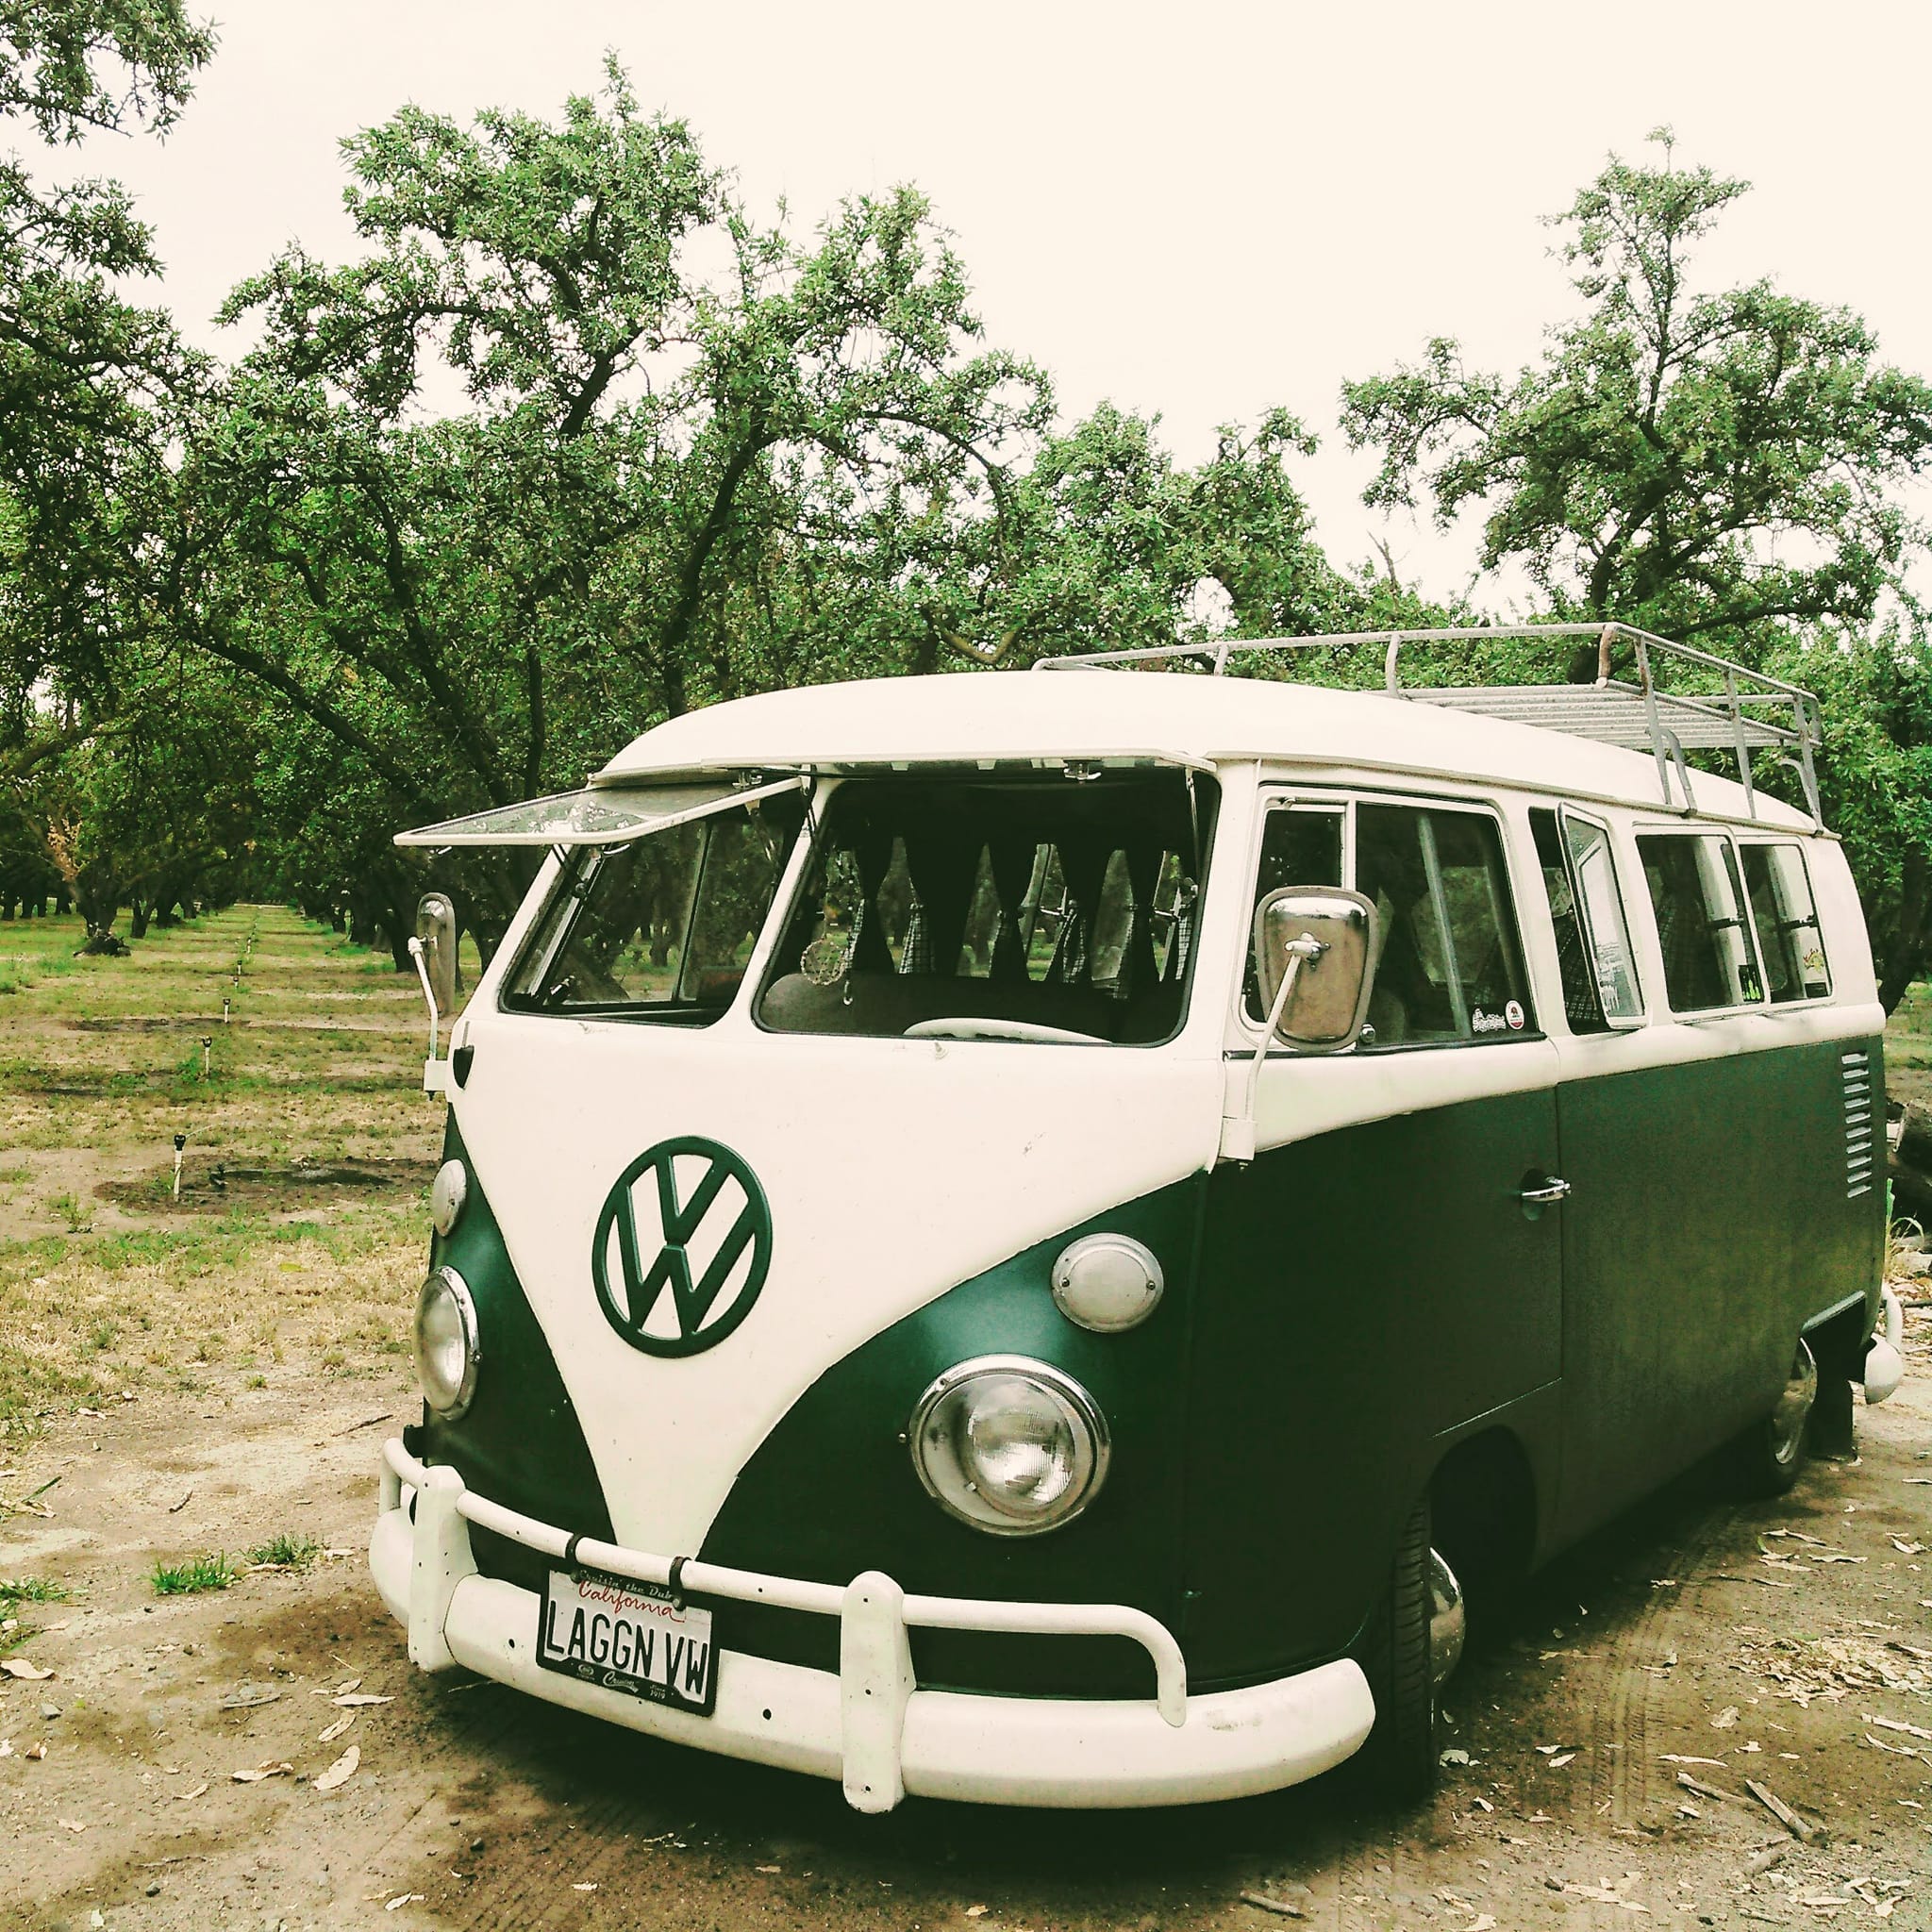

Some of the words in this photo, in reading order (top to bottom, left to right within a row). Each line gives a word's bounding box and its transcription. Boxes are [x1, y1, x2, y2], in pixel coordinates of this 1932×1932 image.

[601, 1143, 766, 1350] VW
[578, 1580, 685, 1624] California
[625, 1583, 644, 1594] the
[546, 1600, 655, 1678] LAGGN
[665, 1632, 708, 1695] VW
